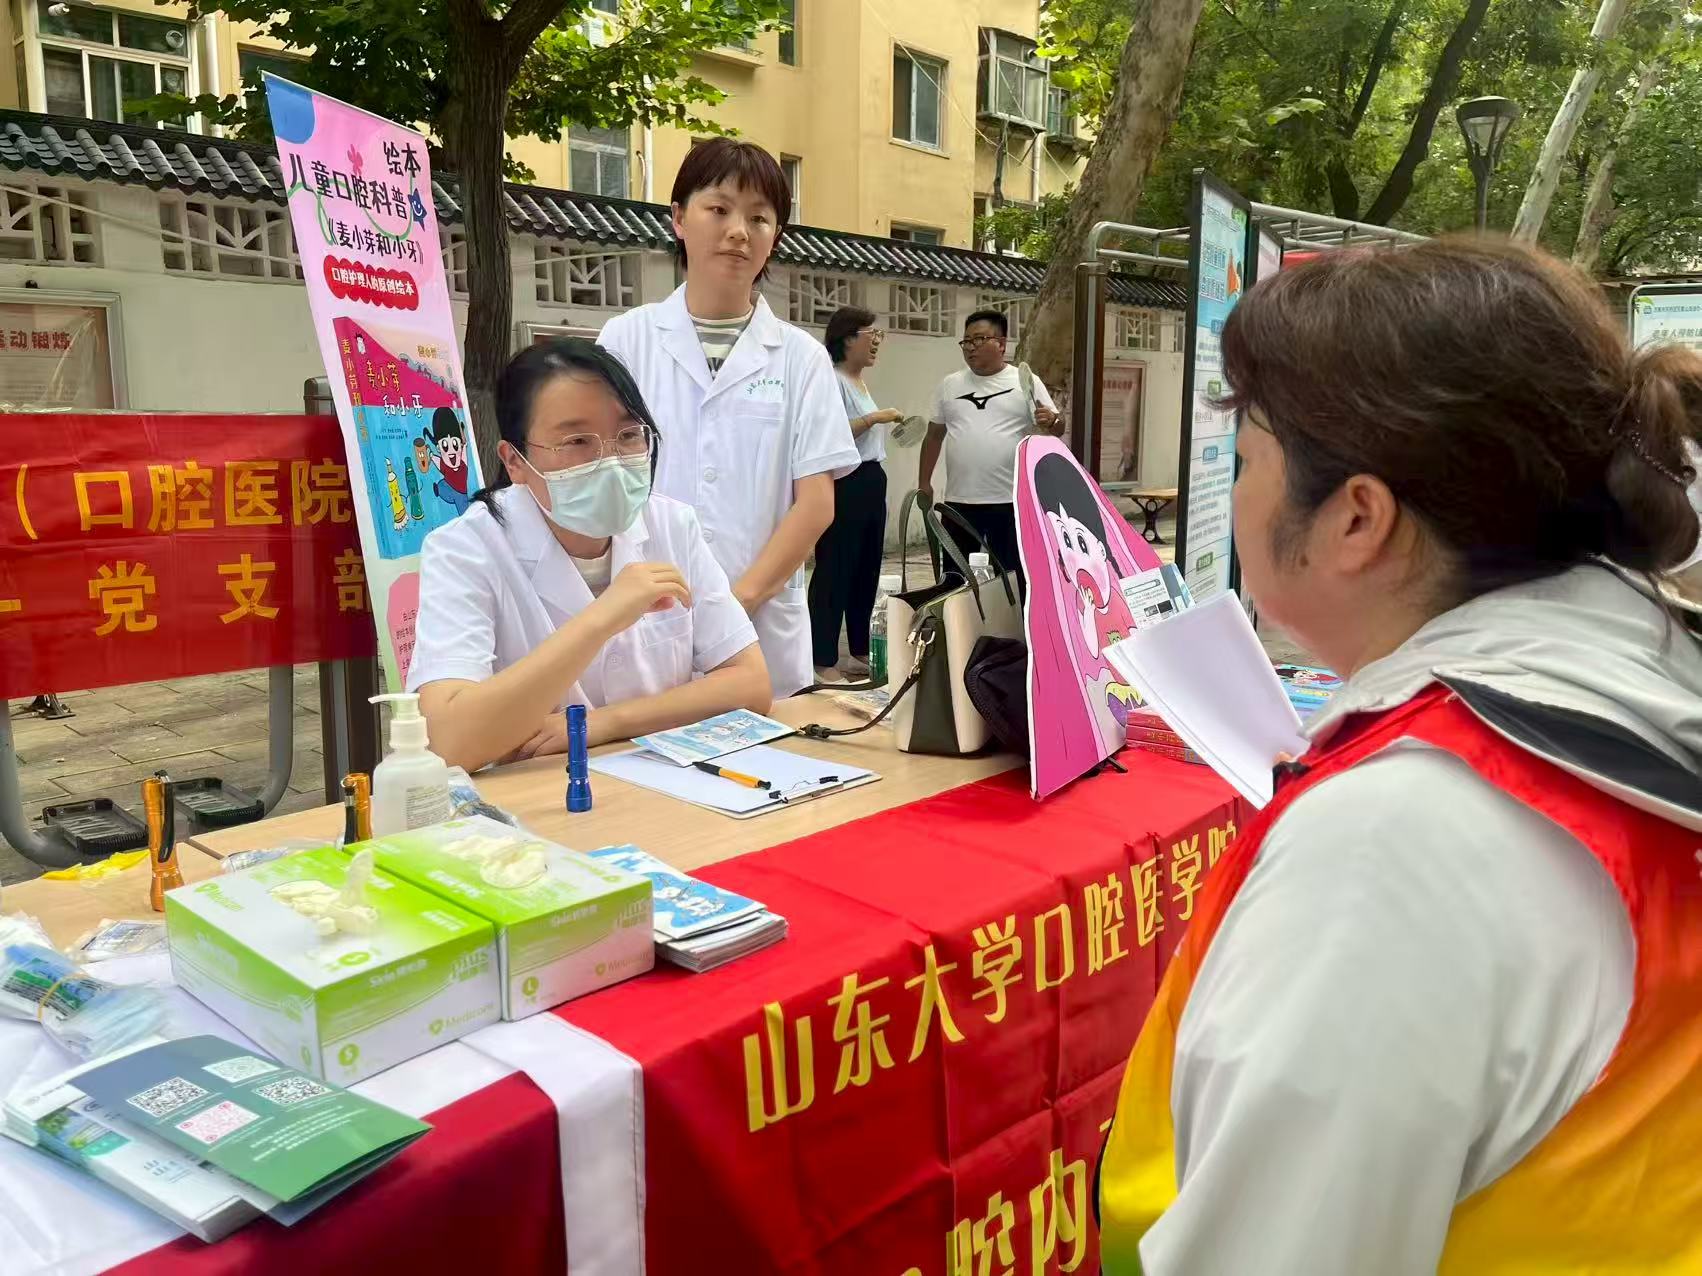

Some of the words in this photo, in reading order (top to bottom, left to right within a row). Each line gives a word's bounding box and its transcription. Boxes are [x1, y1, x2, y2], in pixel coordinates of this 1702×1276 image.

[383, 141, 421, 178] 绘本
[289, 153, 407, 220] 儿童口腔科普
[328, 217, 424, 264] 《麦小芽和小牙》
[331, 267, 415, 296] 口腔护理人的原创绘本
[382, 394, 423, 418] 和小牙
